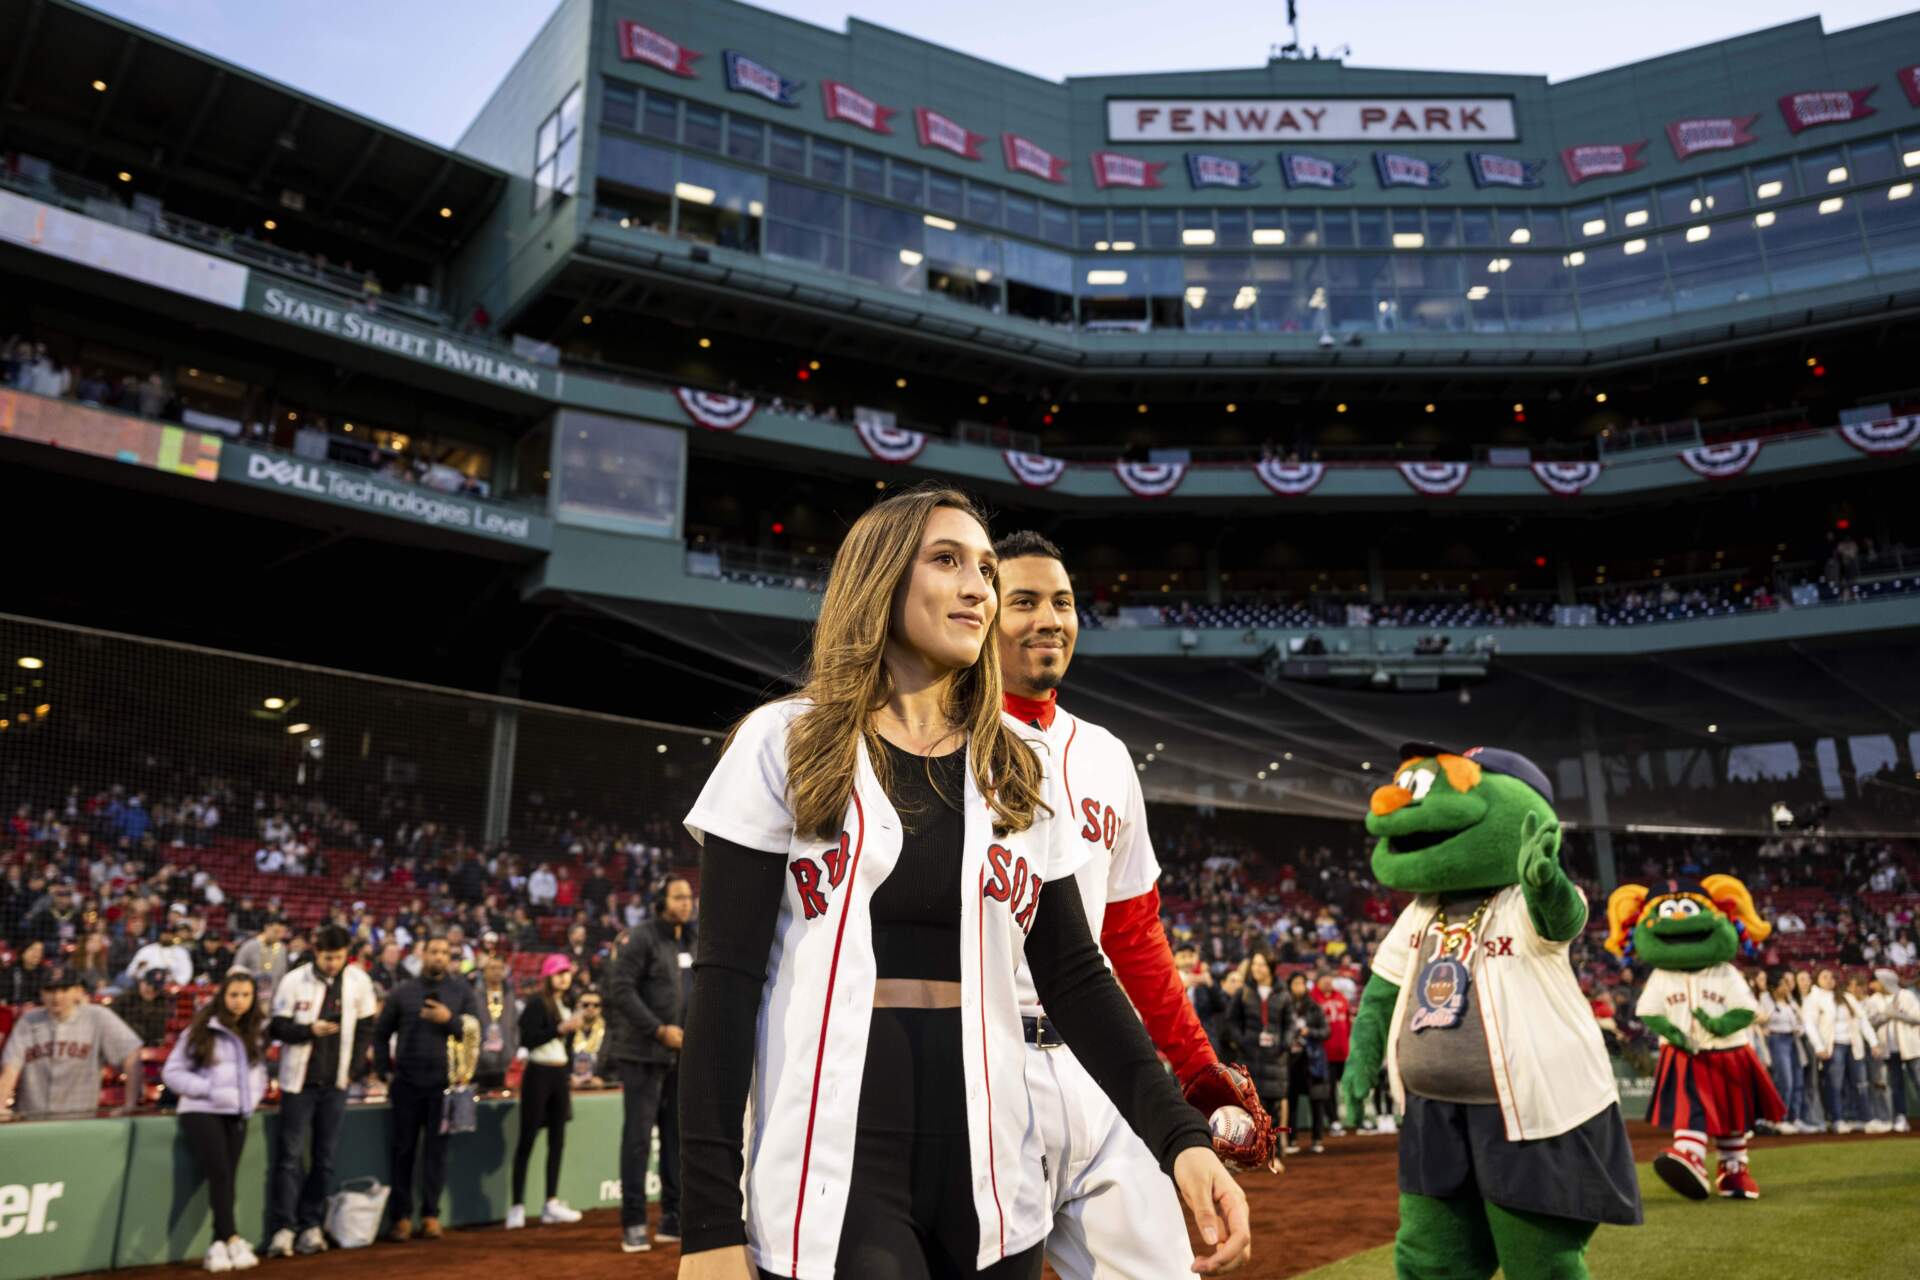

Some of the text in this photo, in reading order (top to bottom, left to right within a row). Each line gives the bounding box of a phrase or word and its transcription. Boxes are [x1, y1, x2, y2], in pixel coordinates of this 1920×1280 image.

[1137, 107, 1486, 132] FENWAY PARK
[264, 288, 539, 390] STATE STREET PAVILION
[248, 454, 529, 538] DELL Technologies Level
[1081, 797, 1121, 854] SO
[24, 1041, 93, 1063] BOSTON
